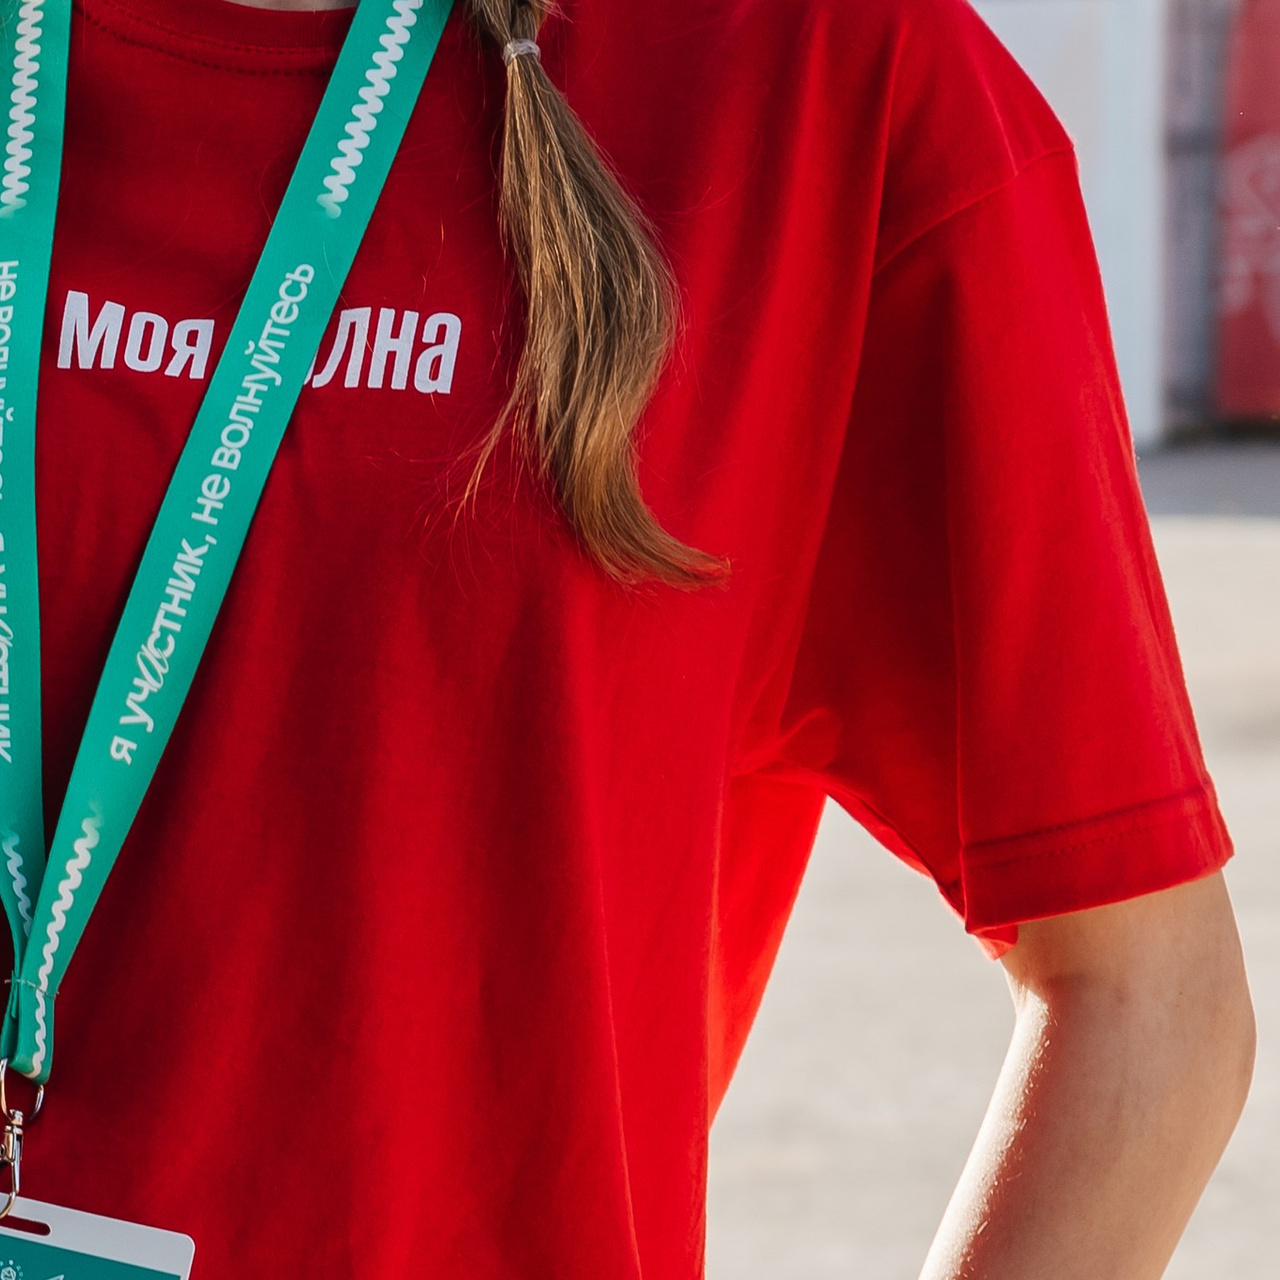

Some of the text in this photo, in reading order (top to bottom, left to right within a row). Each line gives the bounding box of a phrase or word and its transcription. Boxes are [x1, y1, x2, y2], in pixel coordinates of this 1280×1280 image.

[57, 290, 462, 394] Моя лна
[110, 263, 315, 765] я участник, не волнуйтесь
